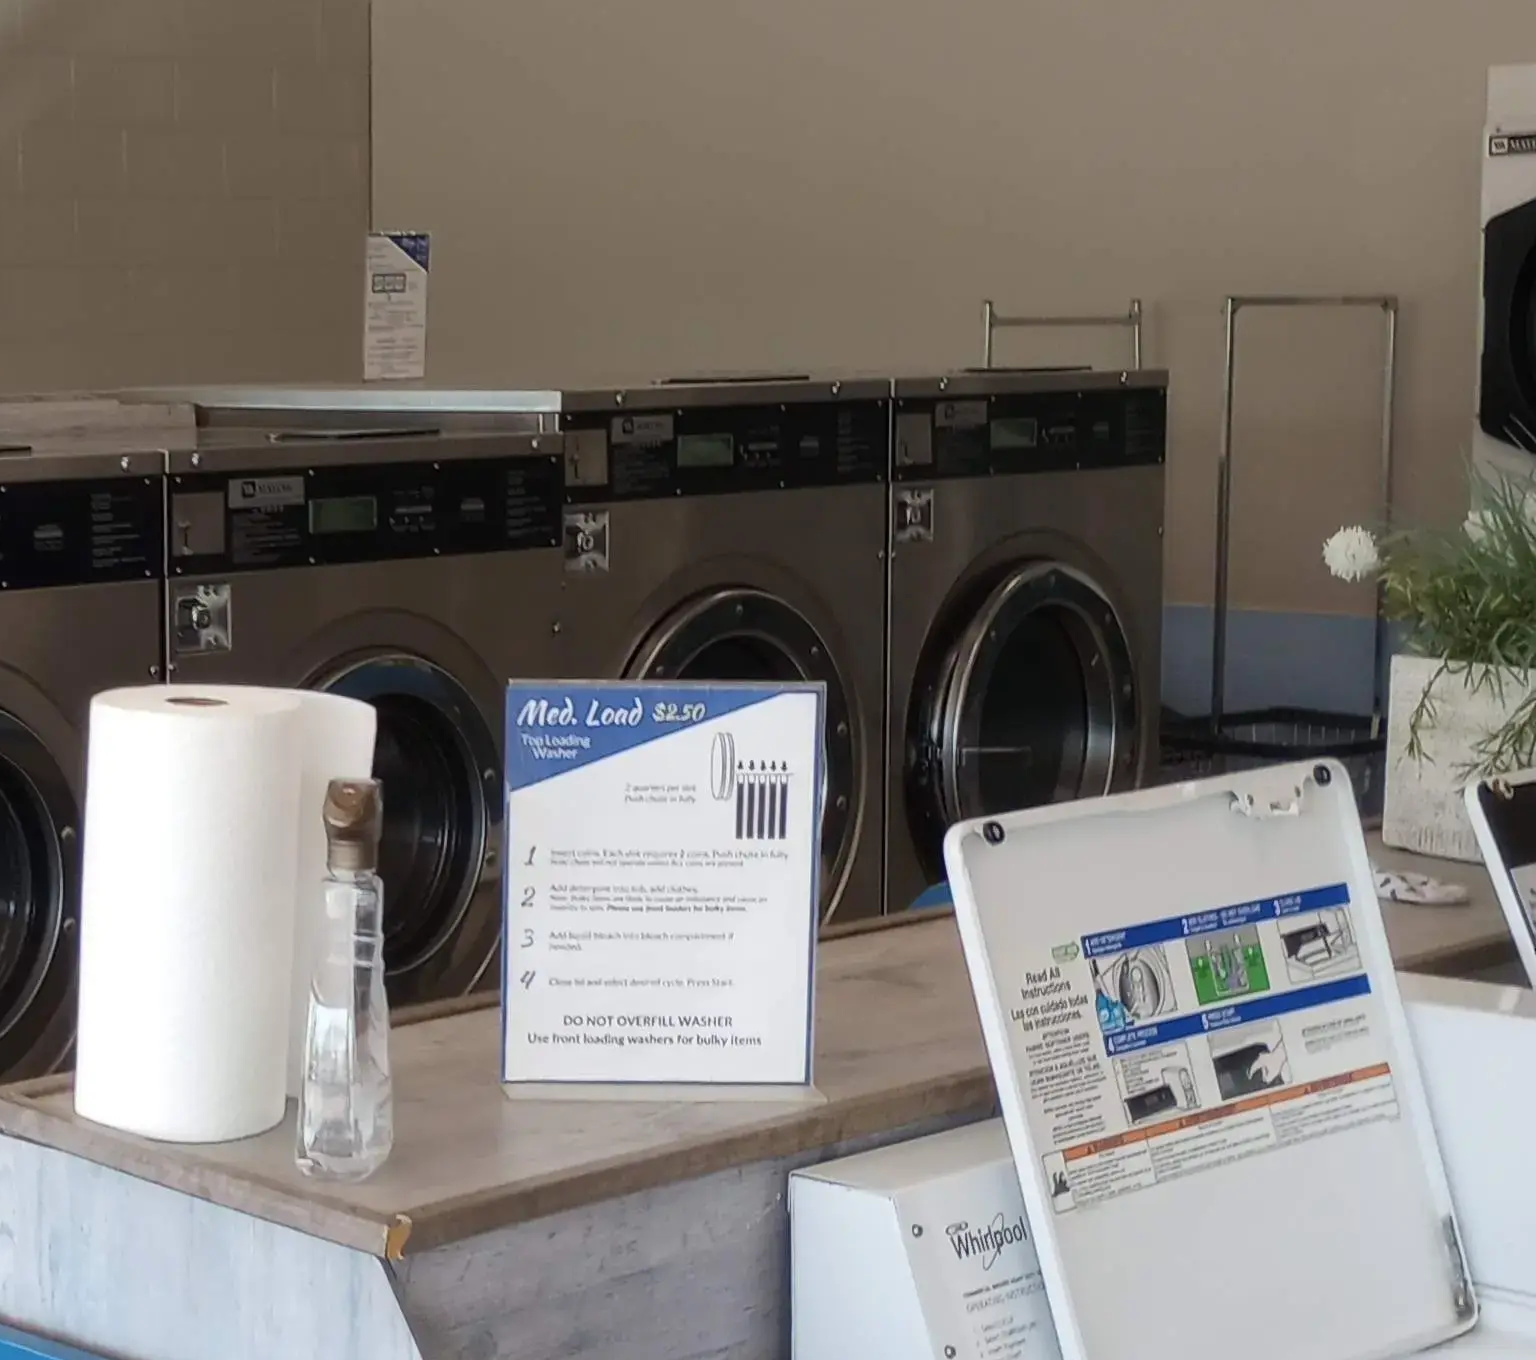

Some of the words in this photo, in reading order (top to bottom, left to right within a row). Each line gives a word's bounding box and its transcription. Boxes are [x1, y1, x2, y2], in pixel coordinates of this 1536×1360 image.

[517, 697, 578, 727] Med.
[585, 697, 645, 727] Load
[652, 702, 706, 722] $2.50
[545, 733, 591, 749] Loading
[532, 747, 578, 760] Washer
[524, 846, 537, 866] 1
[521, 886, 536, 907] 2
[520, 928, 535, 949] 3
[520, 970, 537, 990] 4
[563, 1014, 584, 1027] DO
[586, 1014, 614, 1027] NOT
[616, 1015, 676, 1027] OVERFILL
[677, 1015, 733, 1028] WASHER
[527, 1032, 550, 1044] Use
[552, 1032, 581, 1045] front
[583, 1032, 625, 1046] loading
[626, 1034, 674, 1046] washers
[676, 1034, 694, 1045] for
[696, 1034, 729, 1048] bulky
[730, 1034, 762, 1046] items
[950, 1215, 1028, 1260] Whirlpool
